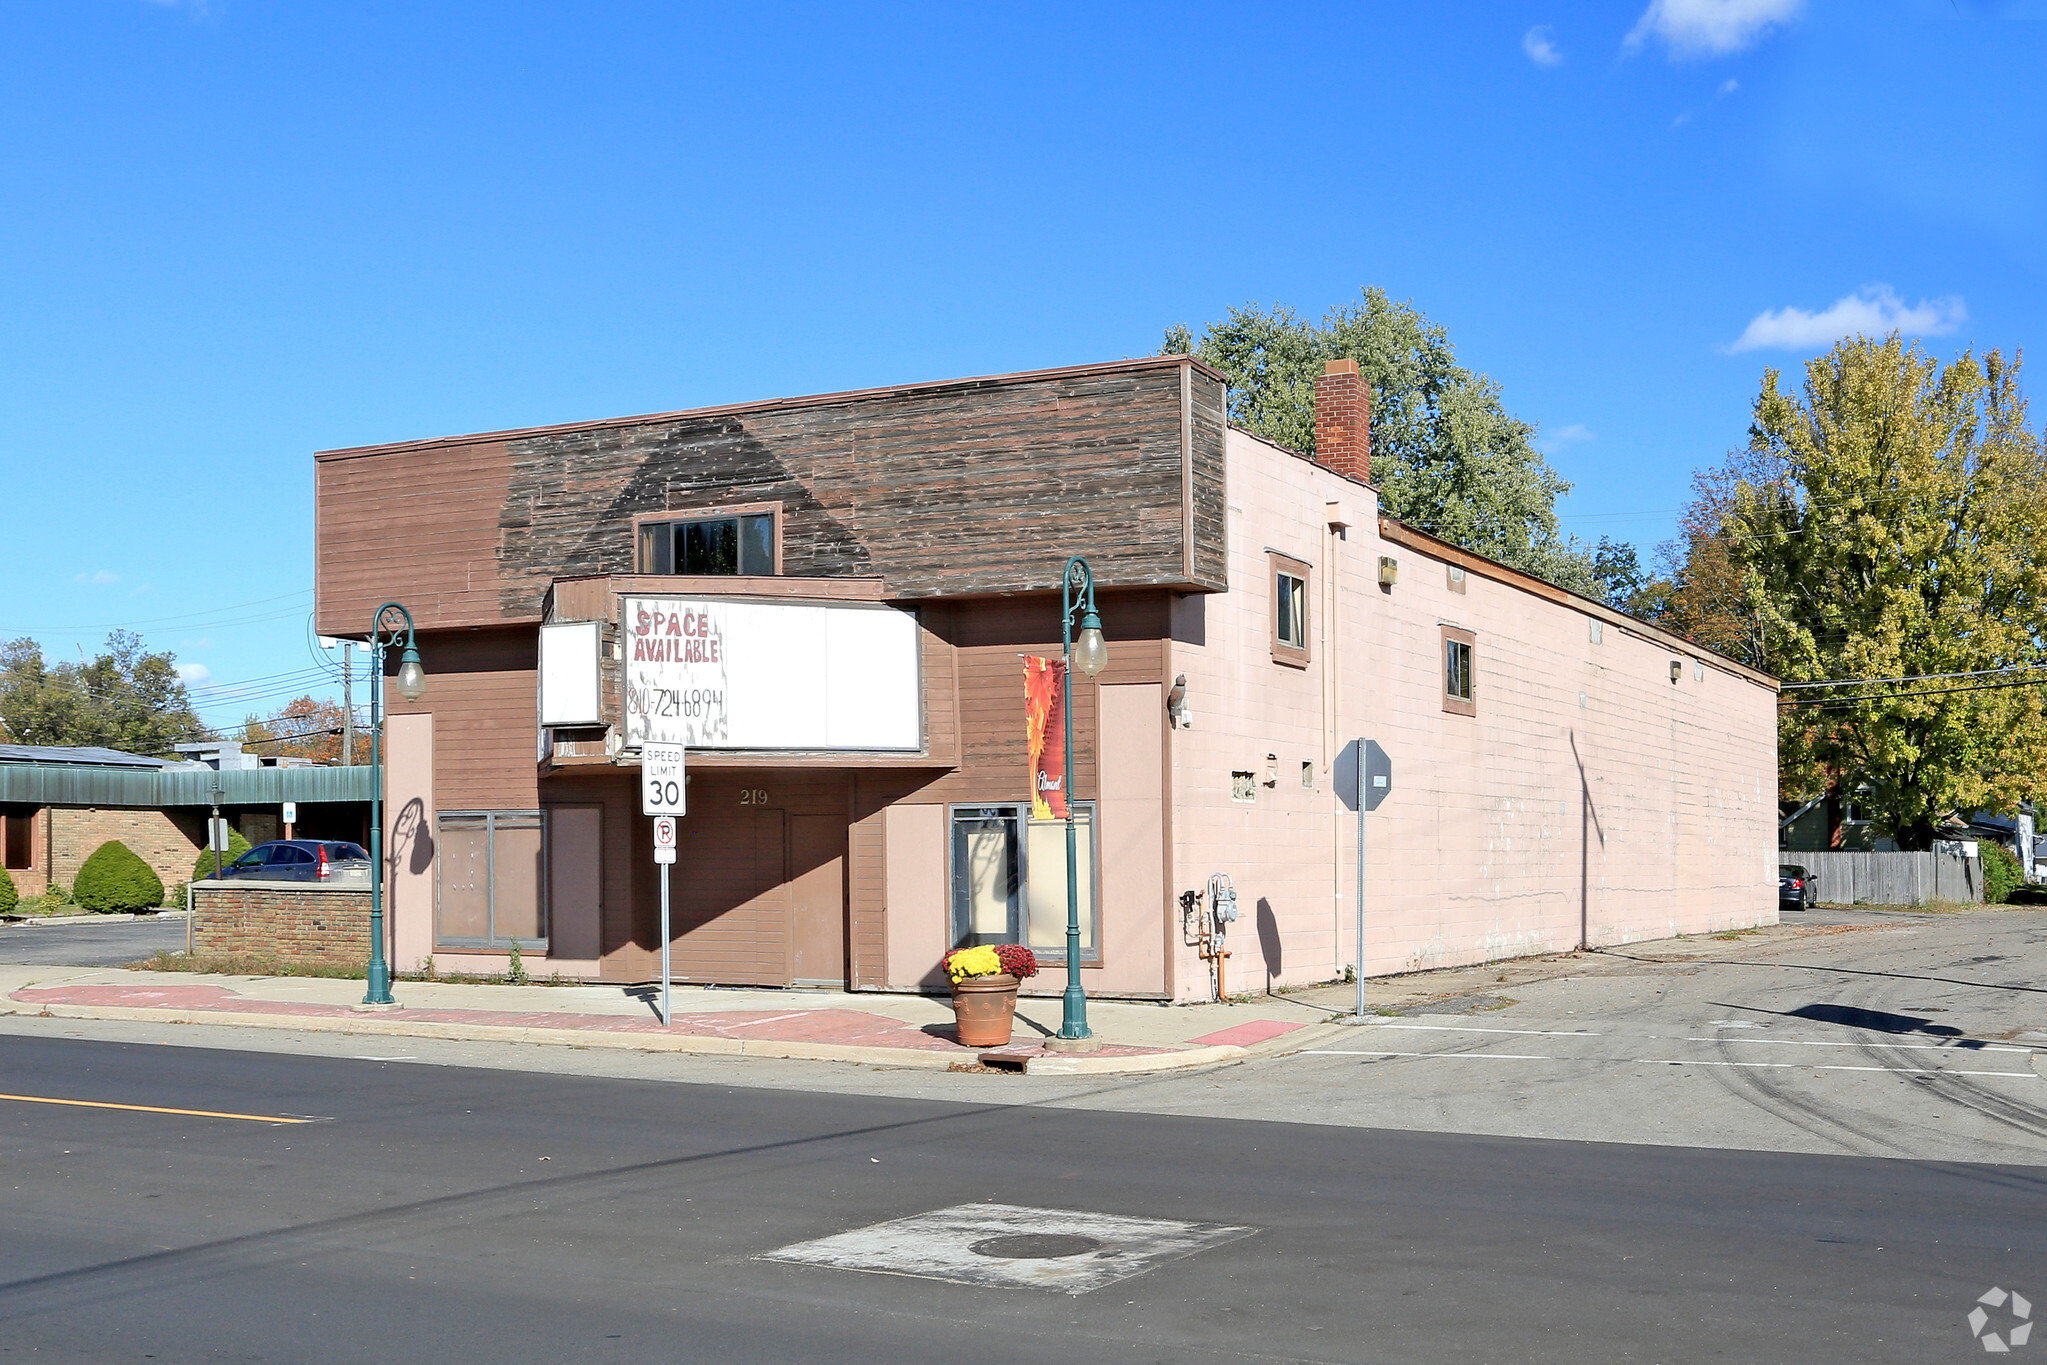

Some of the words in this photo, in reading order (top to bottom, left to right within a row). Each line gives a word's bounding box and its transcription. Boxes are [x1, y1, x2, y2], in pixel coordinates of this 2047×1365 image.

[636, 610, 708, 638] SPACE
[634, 638, 718, 663] AVAILABLE
[628, 687, 723, 720] 810-724-6894
[647, 750, 681, 762] SPEED
[650, 766, 676, 776] LIMIT
[650, 780, 679, 806] 30
[740, 789, 768, 805] 219
